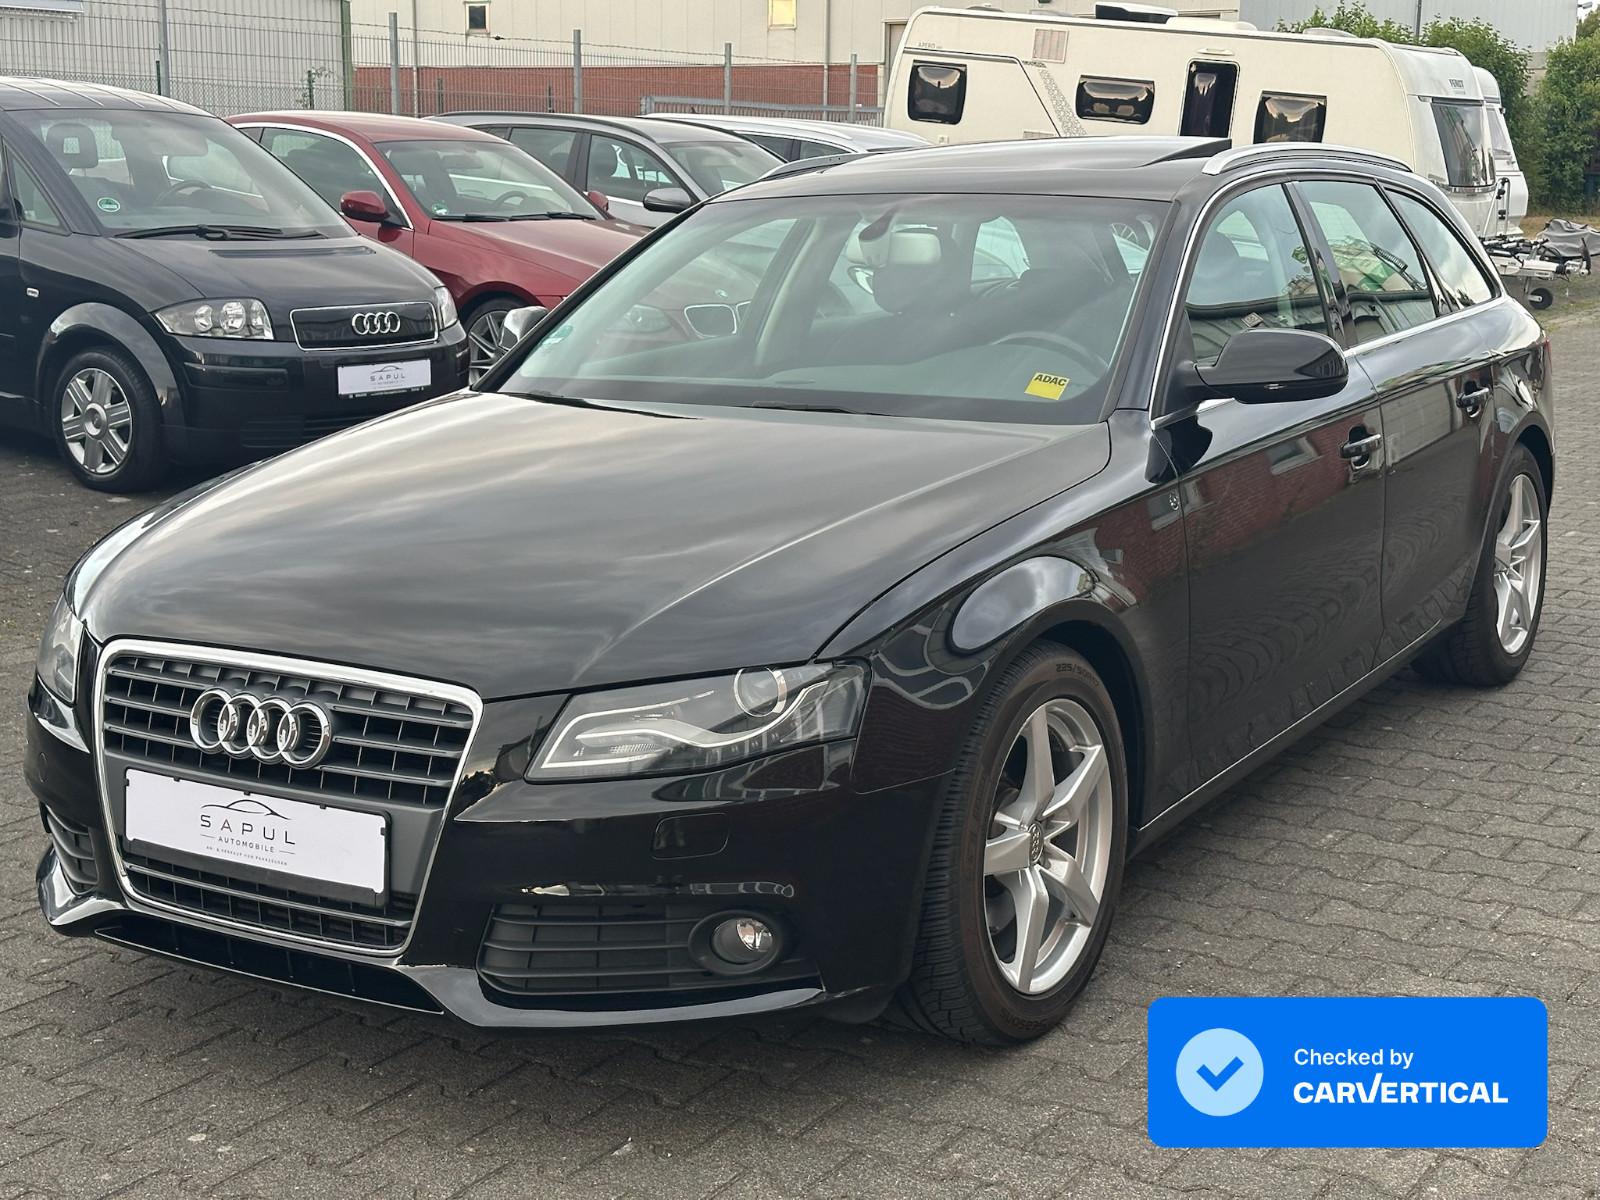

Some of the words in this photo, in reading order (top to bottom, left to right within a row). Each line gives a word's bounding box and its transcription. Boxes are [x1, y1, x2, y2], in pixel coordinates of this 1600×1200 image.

[370, 373, 405, 381] SAPUL
[1034, 374, 1067, 386] ADAC
[200, 814, 295, 845] SAPUL
[218, 836, 274, 853] AUTOMOBILE
